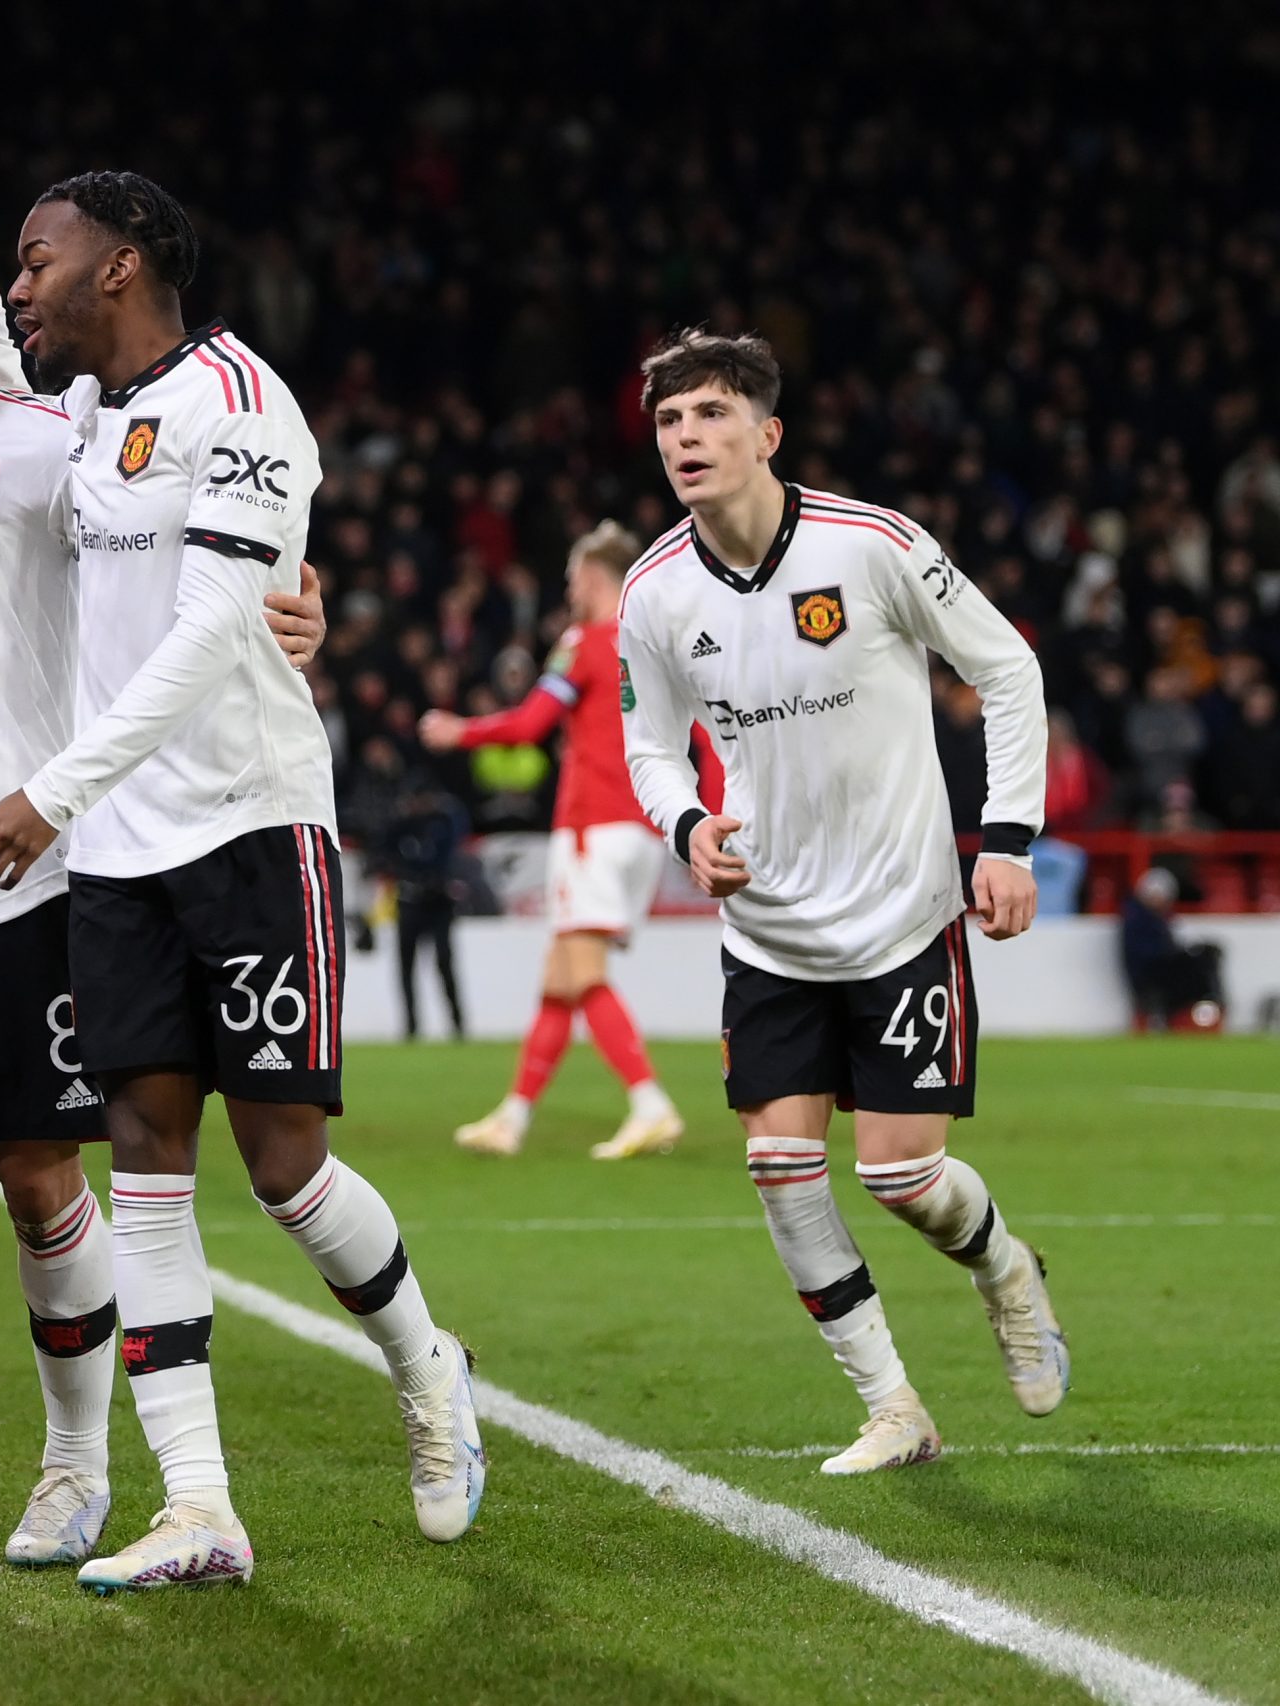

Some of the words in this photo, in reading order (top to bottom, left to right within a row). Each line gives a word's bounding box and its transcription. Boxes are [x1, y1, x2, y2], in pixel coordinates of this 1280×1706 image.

[209, 446, 290, 500] DXC
[206, 488, 287, 514] TECHNOLOGY
[81, 524, 157, 552] TeamViewer
[691, 645, 722, 659] adidas
[734, 688, 856, 728] TeamViewer
[220, 954, 307, 1035] 36
[46, 993, 83, 1073] 8
[879, 984, 949, 1059] 49
[247, 1059, 293, 1070] adidas
[913, 1078, 947, 1089] adidas
[55, 1095, 99, 1111] adidas
